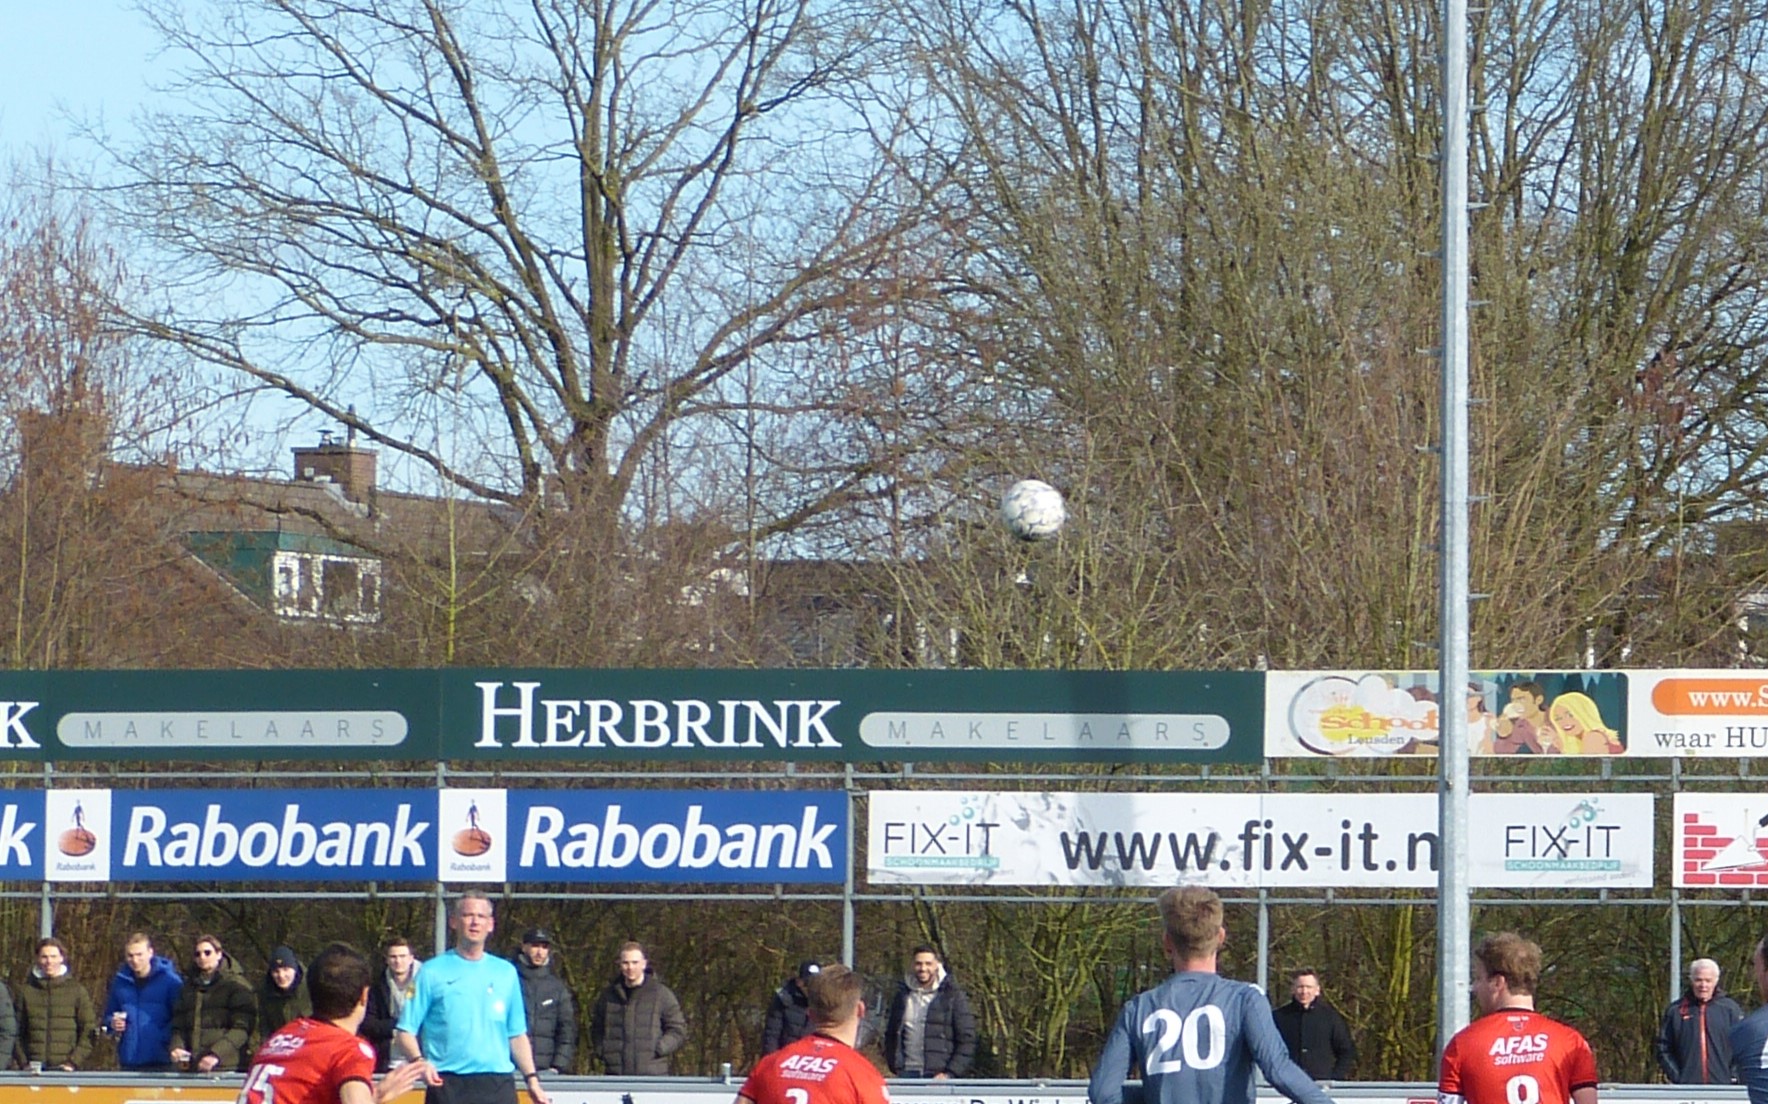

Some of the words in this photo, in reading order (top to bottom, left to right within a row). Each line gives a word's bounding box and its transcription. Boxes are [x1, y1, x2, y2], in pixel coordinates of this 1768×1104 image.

[474, 681, 842, 748] HERBRINK
[84, 720, 384, 739] MAKELAARS
[888, 720, 1206, 741] MAKELAARS
[1349, 735, 1405, 745] Leusden
[1654, 732, 1717, 748] waar
[123, 804, 430, 866] Rabobank
[519, 805, 838, 868] Rabobank
[885, 823, 1000, 854] FIX-IT
[1061, 819, 1440, 871] www.fix-it.n
[1506, 826, 1621, 857] FIX-IT
[1143, 1005, 1225, 1074] 20
[1489, 1034, 1548, 1056] AFAS
[780, 1055, 838, 1073] AFAS
[1493, 1052, 1545, 1066] software
